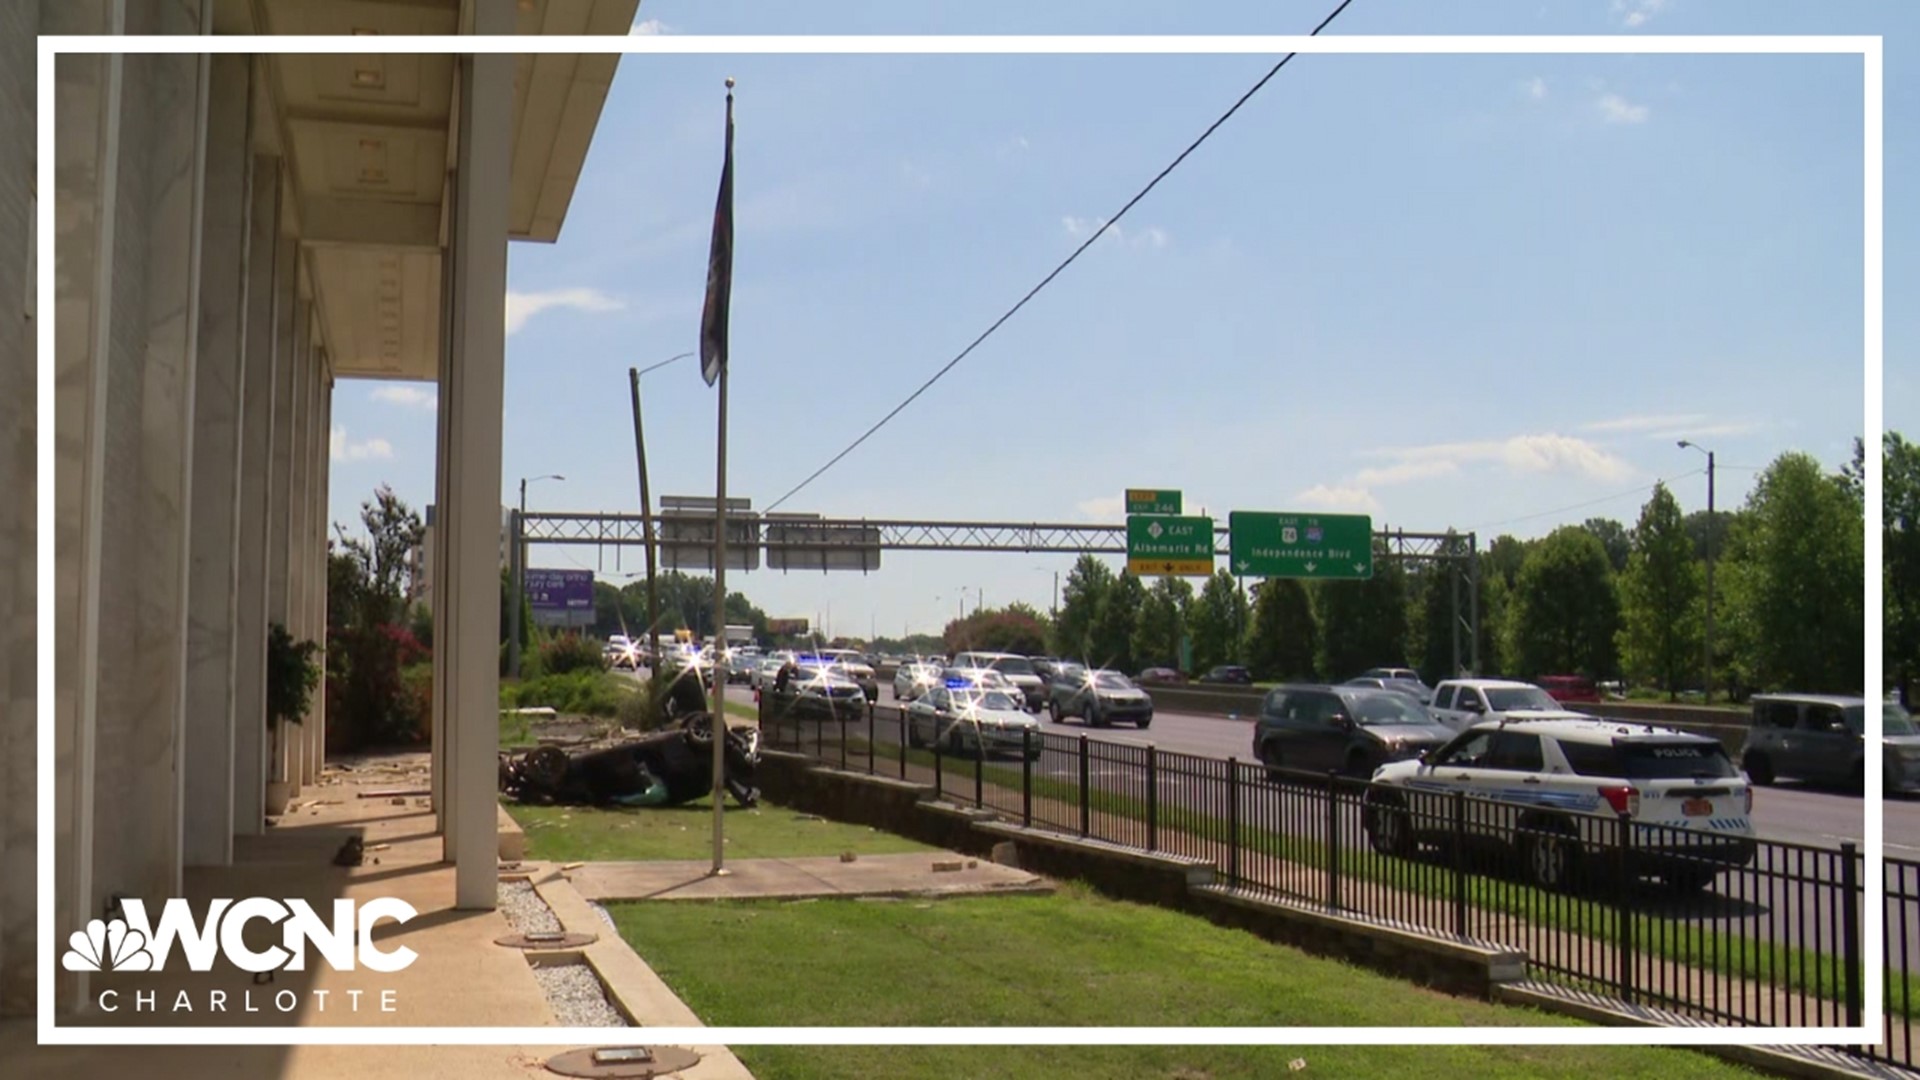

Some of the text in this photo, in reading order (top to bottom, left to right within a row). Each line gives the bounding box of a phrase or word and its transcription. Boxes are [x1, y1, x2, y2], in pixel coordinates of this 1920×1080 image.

[1279, 517, 1298, 525] EAST
[1168, 525, 1194, 536] EAST
[1133, 543, 1209, 554] Albemarle Rd
[1252, 547, 1351, 559] Independence Blvd
[1653, 748, 1702, 759] POLICE
